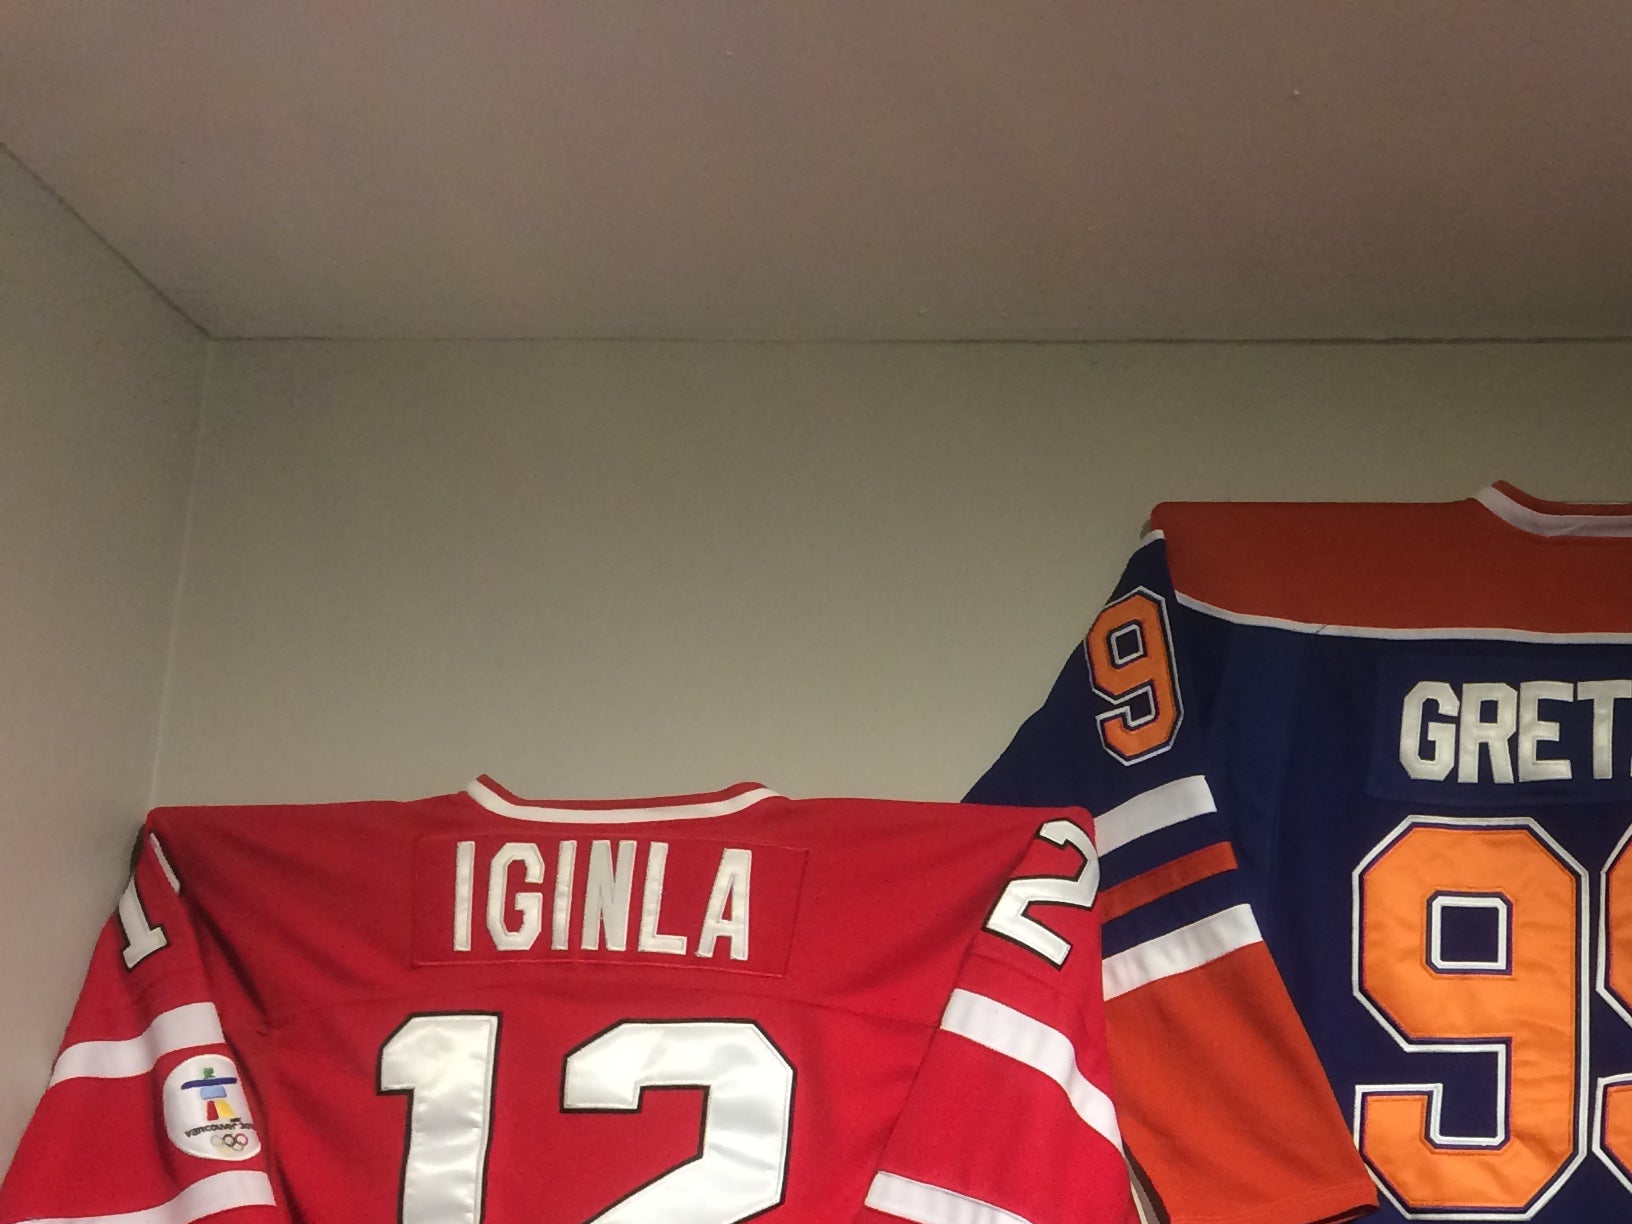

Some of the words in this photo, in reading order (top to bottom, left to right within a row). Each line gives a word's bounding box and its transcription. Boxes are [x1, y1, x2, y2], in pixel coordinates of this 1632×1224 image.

[1084, 585, 1184, 766] 9
[453, 839, 752, 961] IGINLA
[981, 817, 1100, 972] 2
